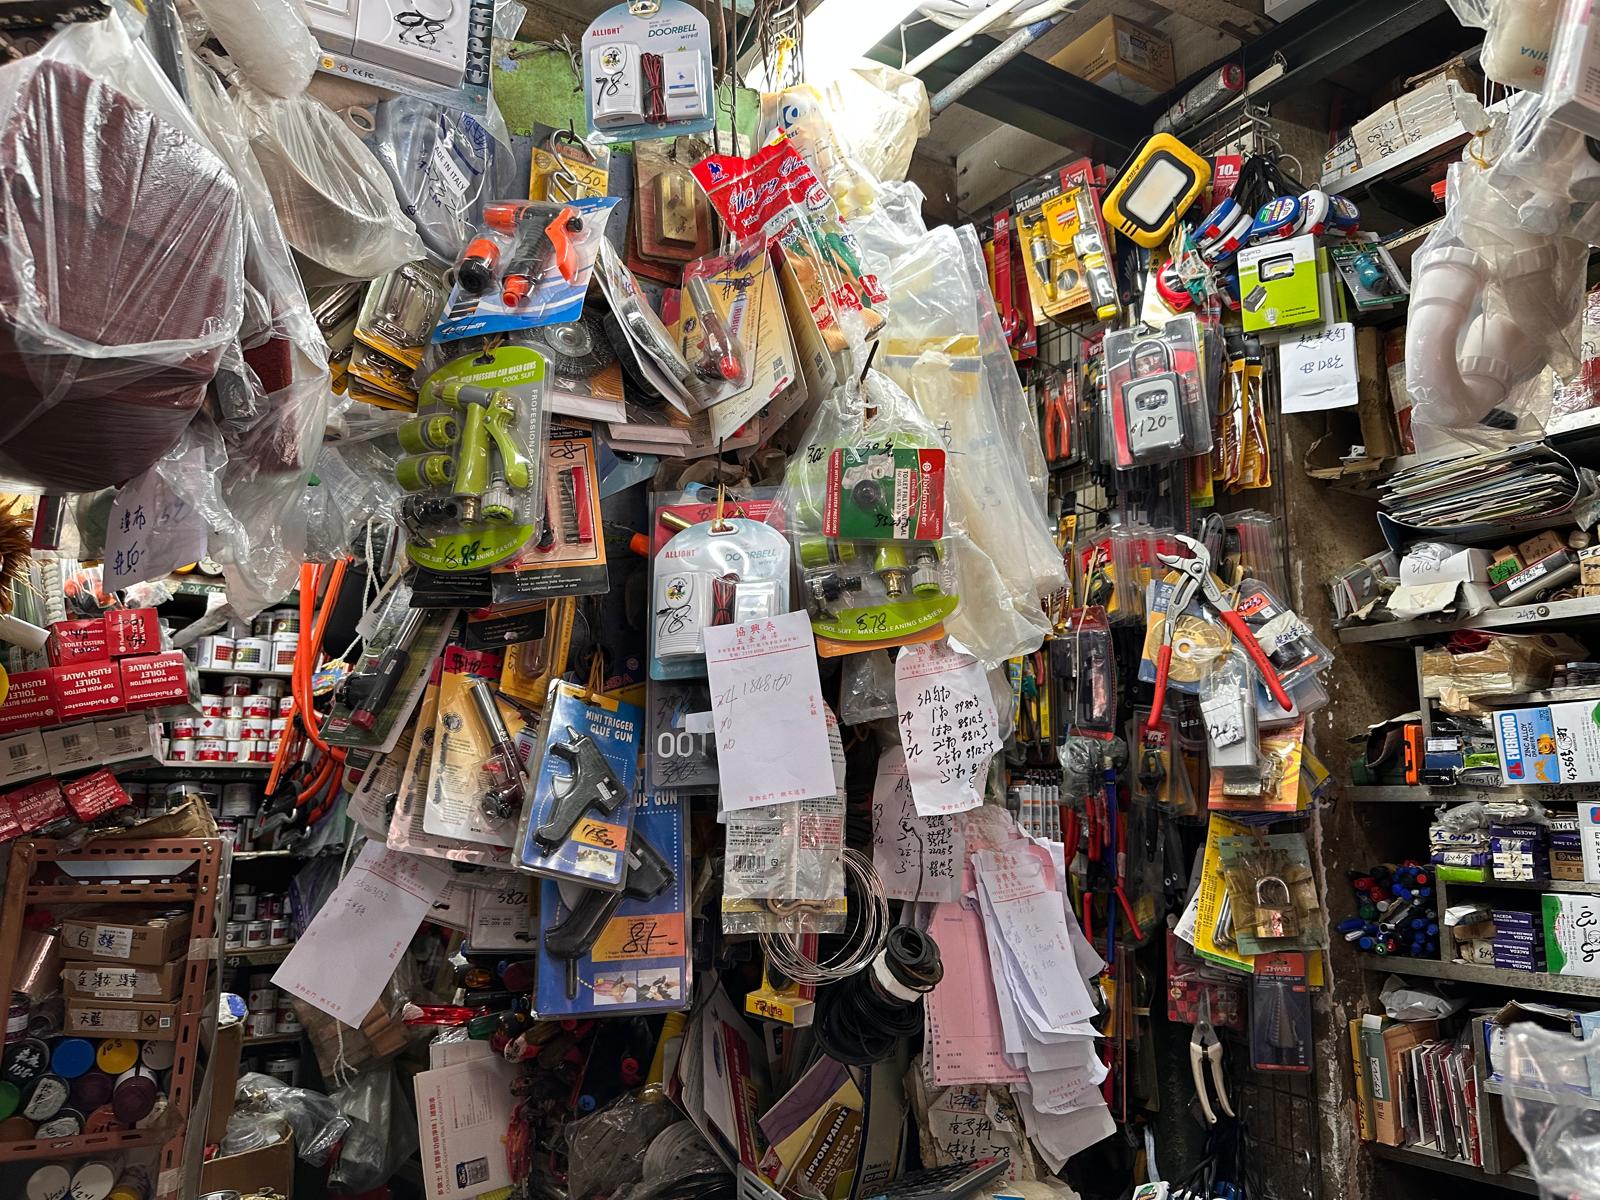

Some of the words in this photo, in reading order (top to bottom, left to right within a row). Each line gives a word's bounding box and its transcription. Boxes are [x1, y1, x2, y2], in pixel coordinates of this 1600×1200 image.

[592, 27, 622, 37] ALLIGHT
[647, 23, 697, 38] DOORBELL
[434, 146, 446, 163] ADE
[449, 169, 467, 190] ITALY
[472, 371, 497, 383] PRESSURE
[497, 369, 507, 378] CAR
[502, 375, 518, 383] COOL
[665, 550, 695, 559] ALLIGHT
[819, 624, 836, 633] COOL
[837, 627, 852, 635] SUIT
[88, 667, 112, 677] FLUSH
[128, 663, 149, 673] VALVE
[61, 672, 87, 682] VALVE
[140, 669, 167, 679] TOILET
[22, 679, 47, 690] FLUSH
[75, 678, 102, 688] TOILET
[130, 679, 152, 687] BUTTON
[152, 676, 166, 684] PUSH
[9, 689, 36, 700] TOILET
[64, 687, 87, 696] BUTTON
[87, 685, 102, 693] PUSH
[64, 699, 110, 710] Fluidmaster
[0, 709, 45, 722] Fluidmaste
[585, 709, 603, 724] MINI
[604, 712, 634, 732] TRIGGER
[590, 723, 611, 738] GLUE
[614, 731, 633, 743] GUN
[1501, 715, 1520, 760] EVERGOOD
[1520, 722, 1530, 743] ALLOY
[1523, 742, 1532, 758] ZINC
[654, 790, 678, 806] GUN
[827, 1109, 849, 1146] PAINT
